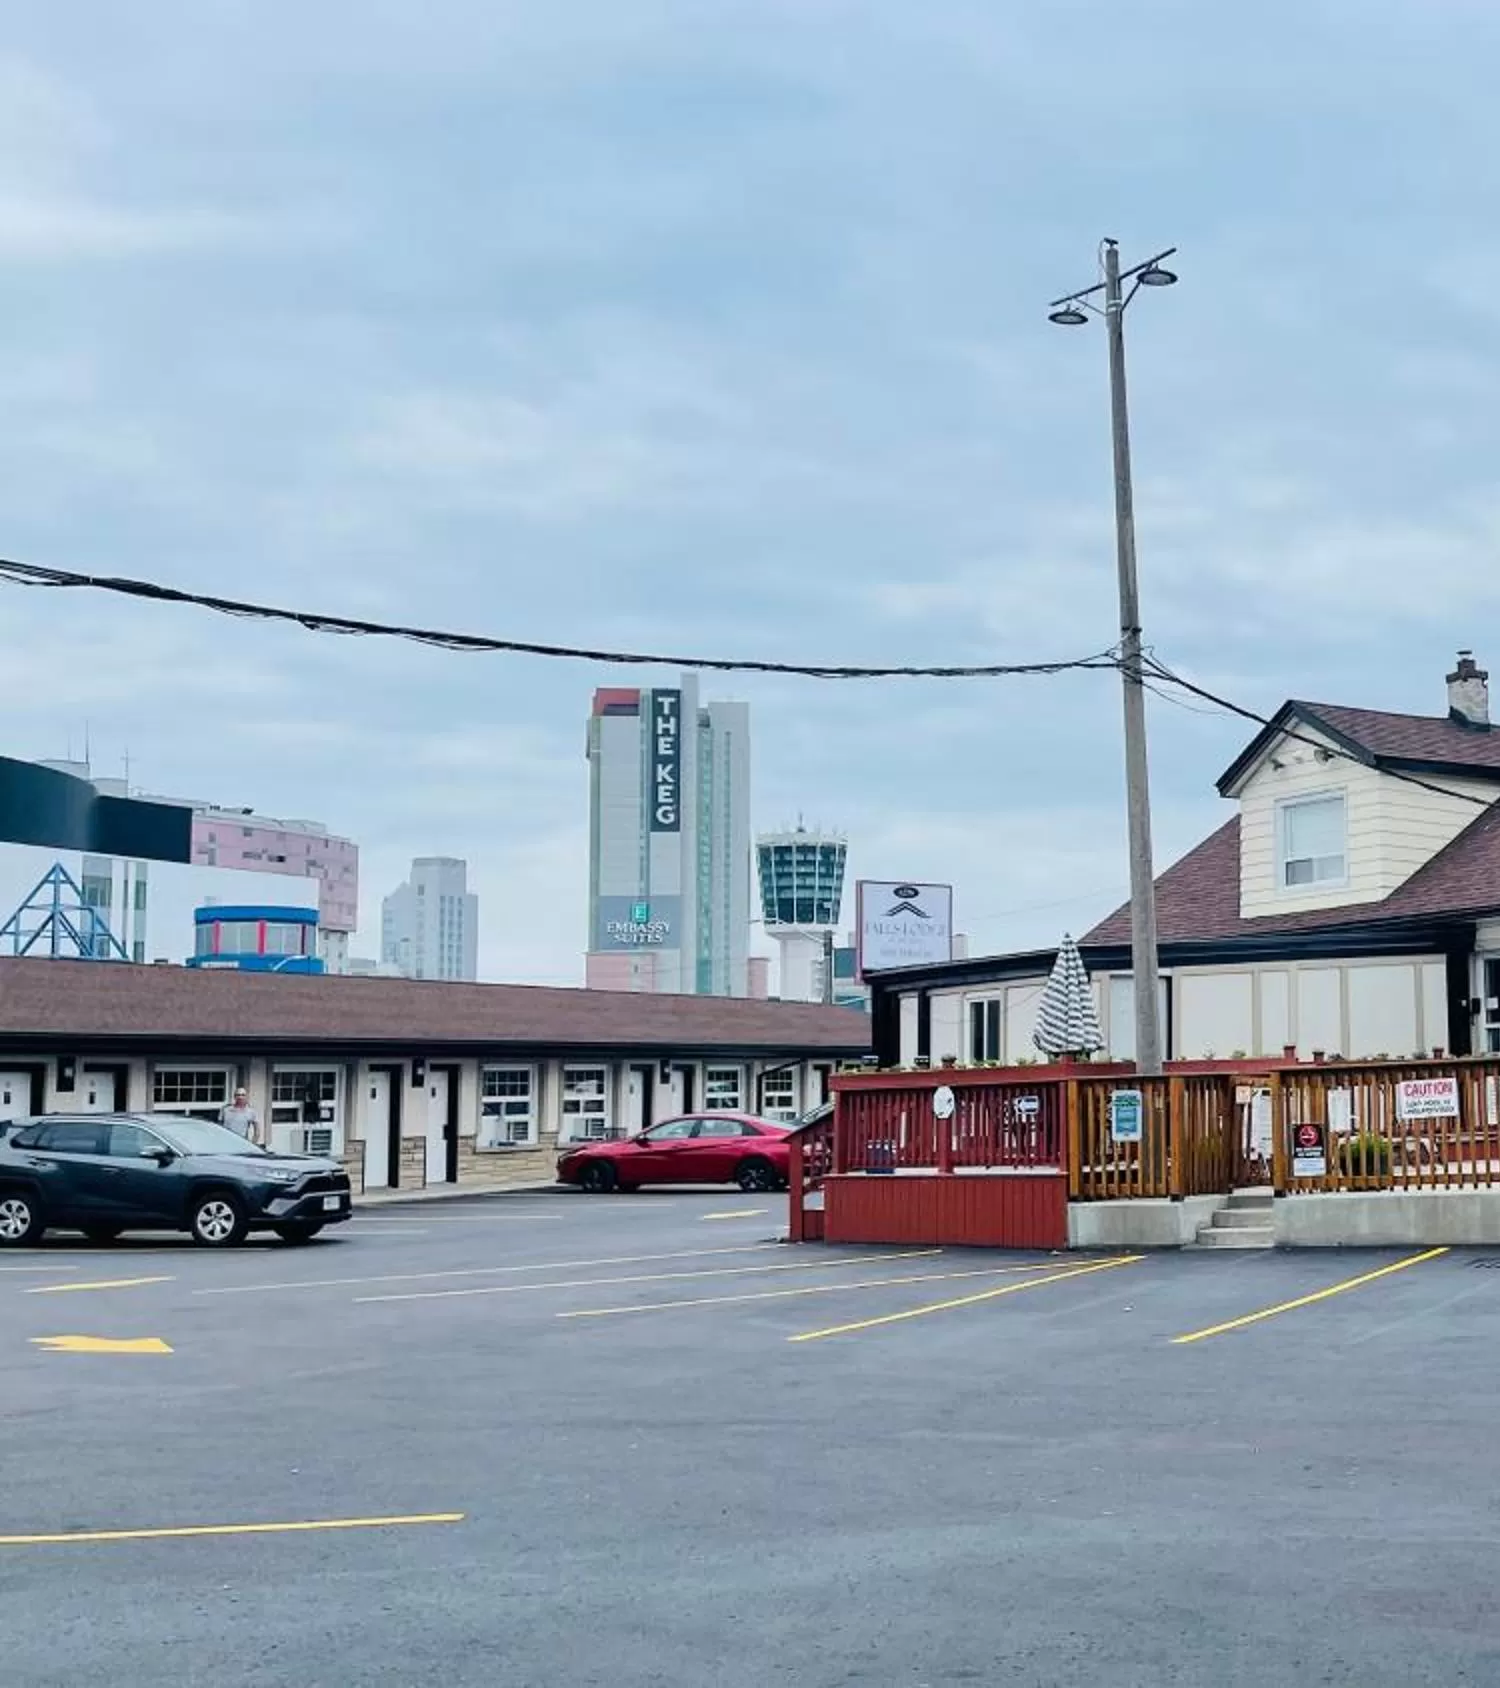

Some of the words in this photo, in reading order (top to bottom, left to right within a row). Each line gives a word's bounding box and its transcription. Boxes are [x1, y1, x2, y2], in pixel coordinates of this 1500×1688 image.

[657, 697, 676, 755] THE
[656, 763, 676, 825] KEG
[607, 921, 670, 932] EMBASSY
[613, 933, 663, 943] SUITES
[1404, 1081, 1453, 1097] CAUTION
